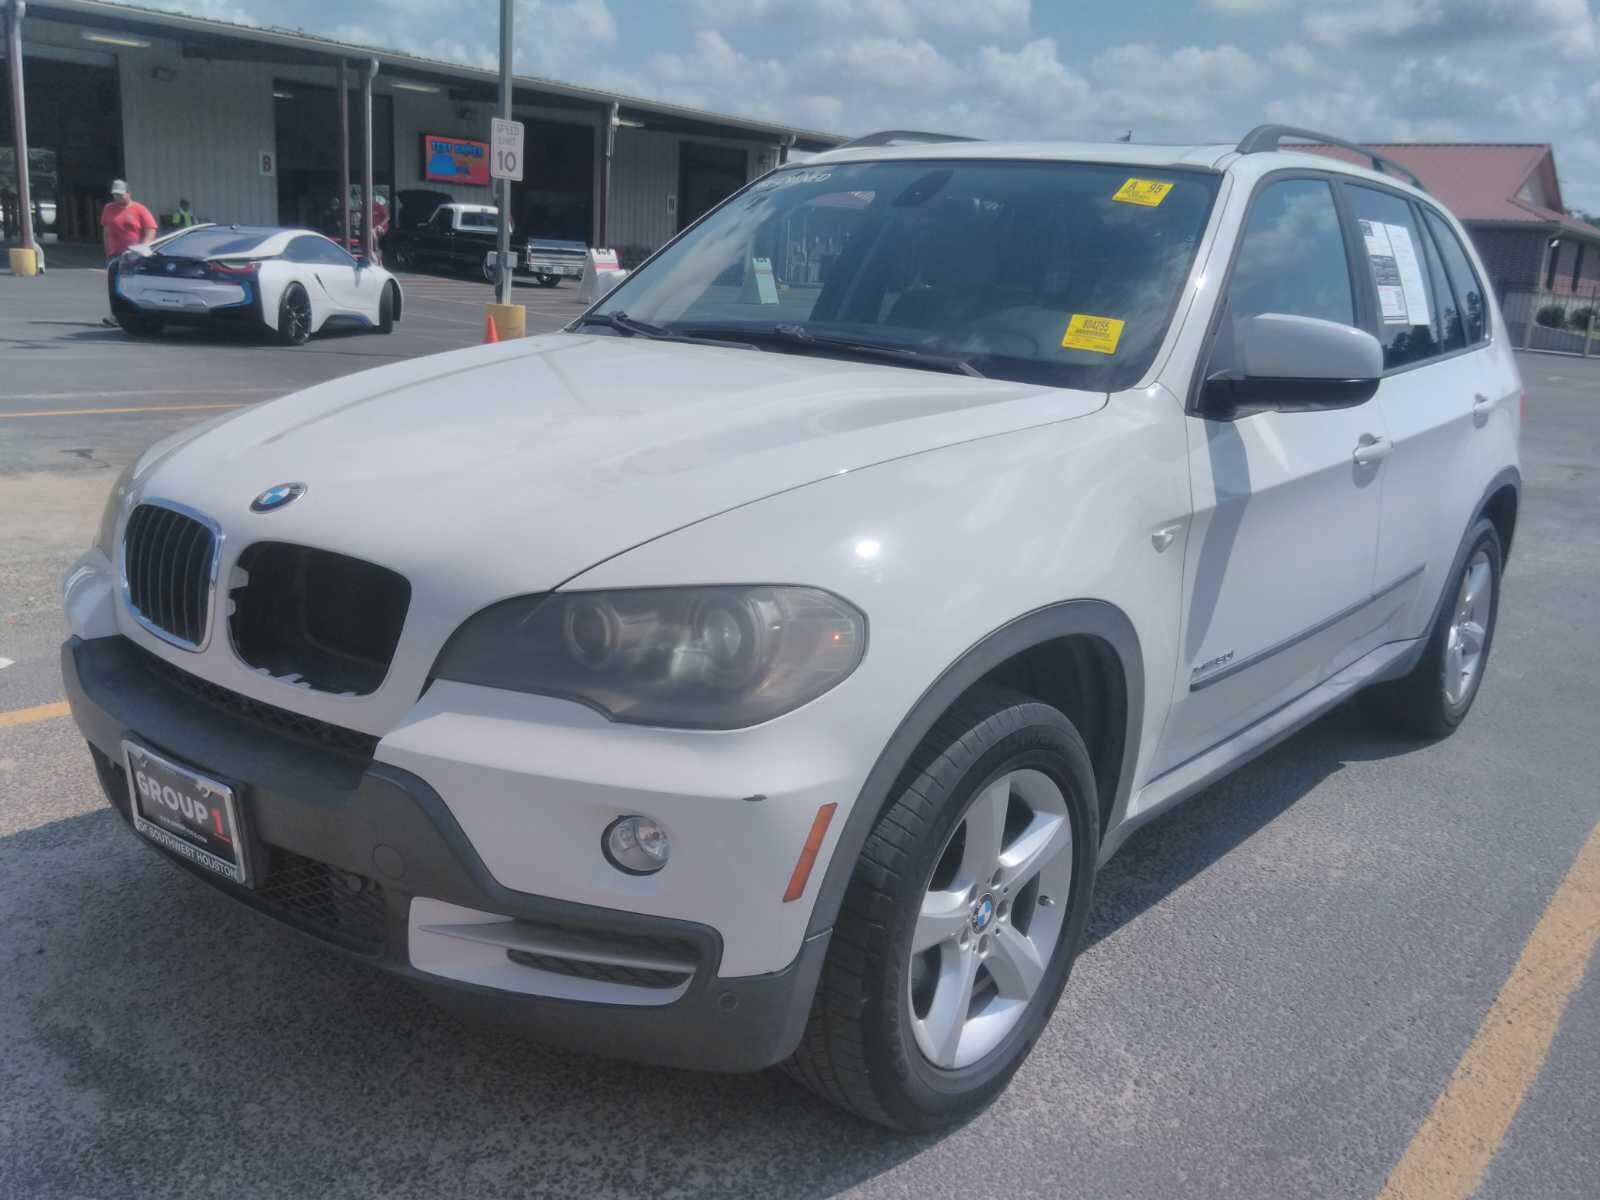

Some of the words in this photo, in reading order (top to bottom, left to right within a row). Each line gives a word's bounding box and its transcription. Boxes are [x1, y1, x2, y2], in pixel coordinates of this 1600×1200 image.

[498, 150, 517, 172] 10
[136, 770, 209, 824] GROUP
[211, 808, 231, 843] 1
[149, 827, 195, 858] SOUTHWEST
[196, 851, 239, 879] HOUSTON
